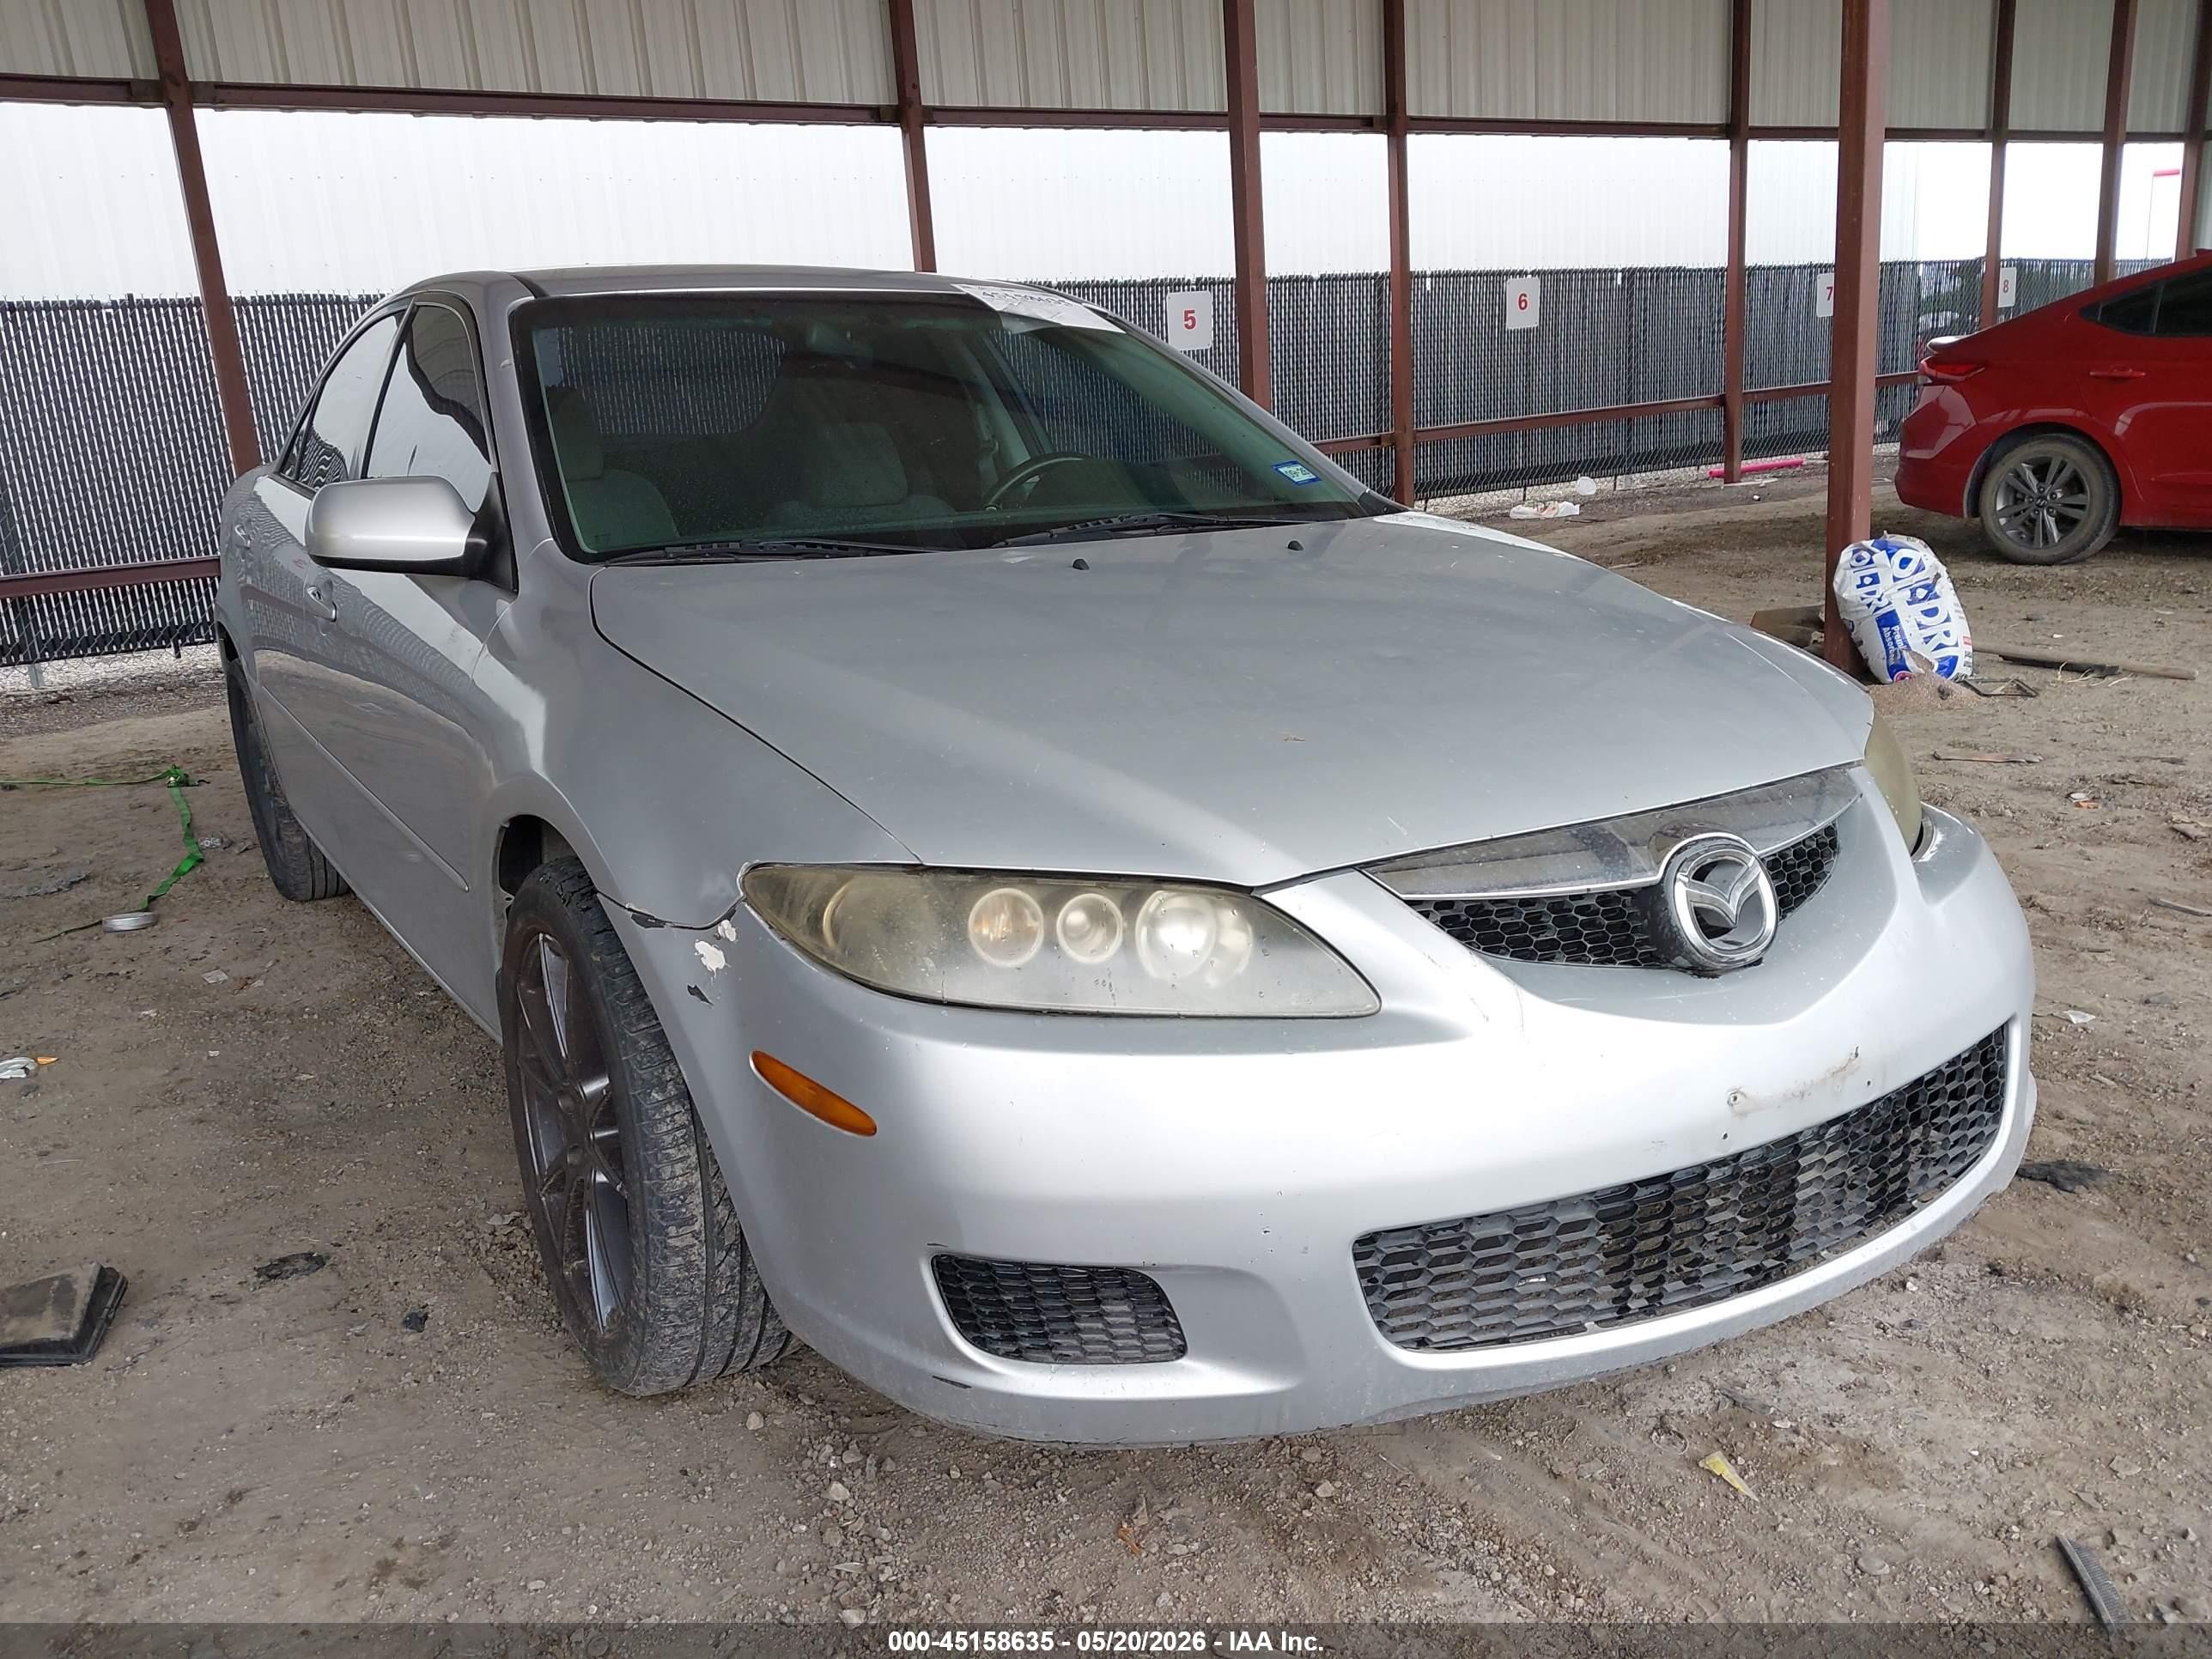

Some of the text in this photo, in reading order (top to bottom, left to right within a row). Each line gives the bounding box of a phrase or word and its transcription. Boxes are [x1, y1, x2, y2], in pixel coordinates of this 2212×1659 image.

[1826, 286, 1833, 301] 7
[2002, 279, 2009, 294] 8
[1518, 293, 1528, 311] 6
[1183, 309, 1196, 330] 5
